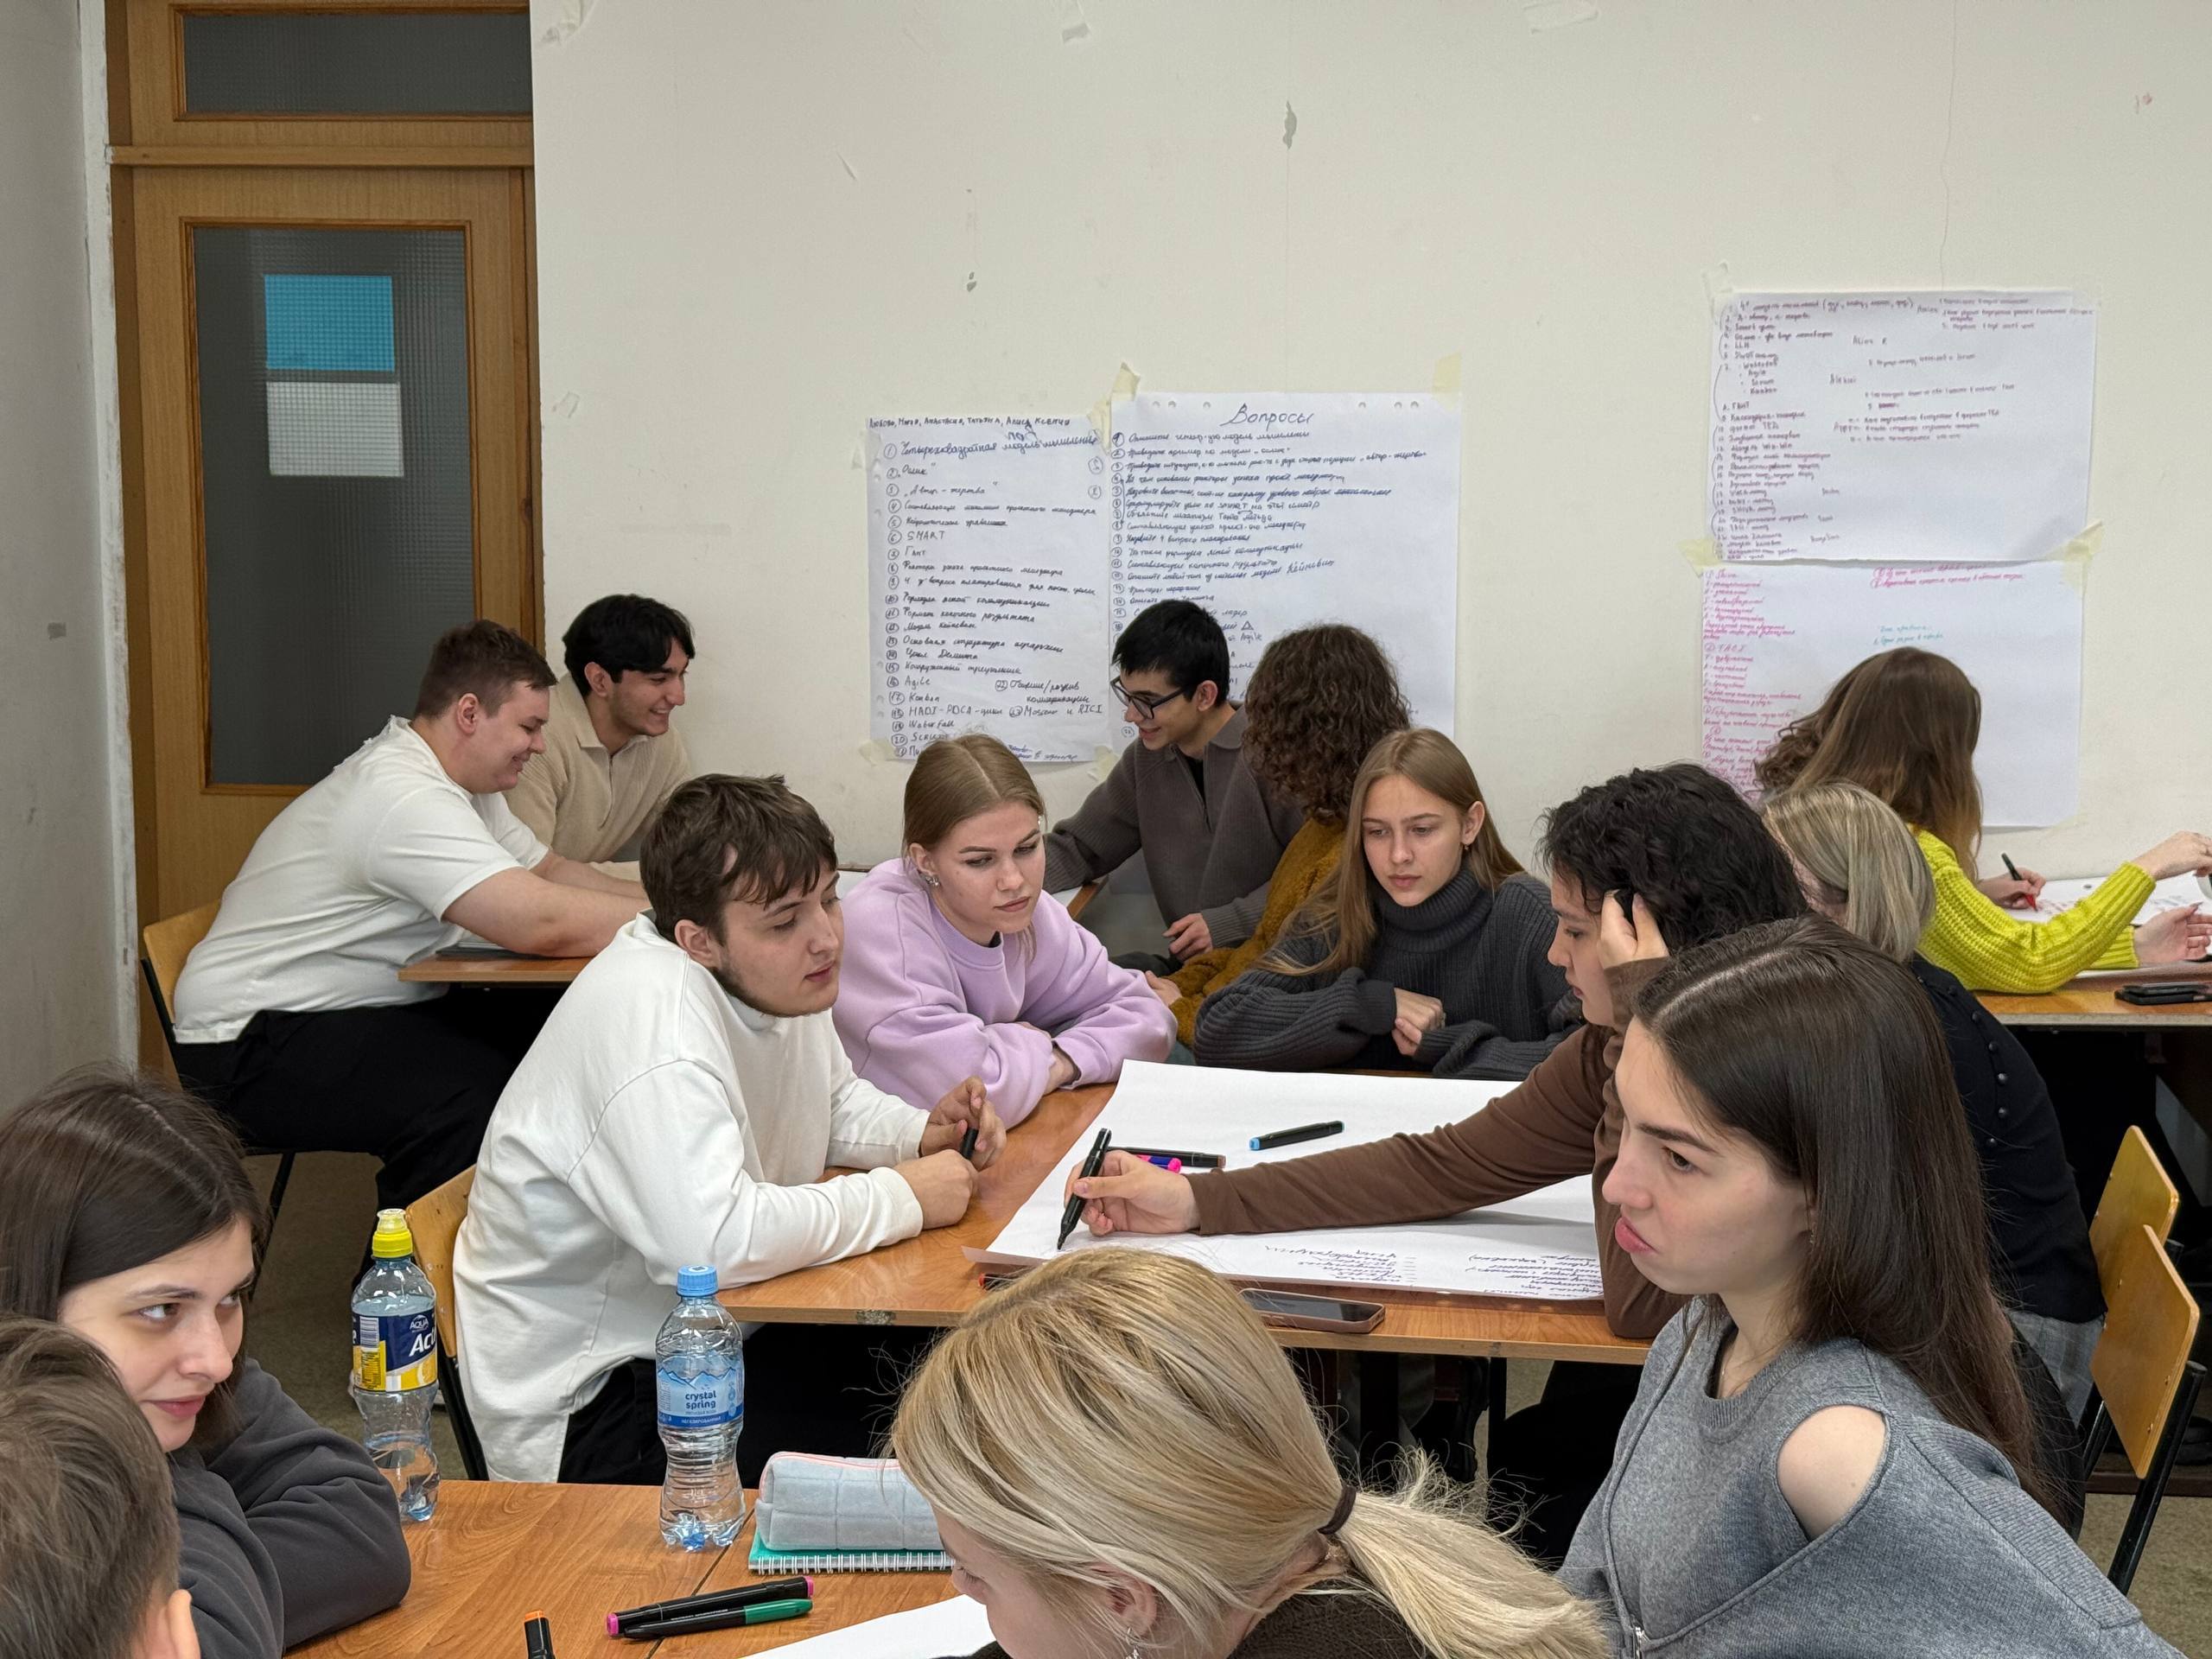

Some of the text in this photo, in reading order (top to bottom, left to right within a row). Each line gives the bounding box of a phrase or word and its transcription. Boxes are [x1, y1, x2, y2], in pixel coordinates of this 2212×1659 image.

[1219, 403, 1314, 431] Вопросы
[410, 1319, 429, 1330] AQUA
[685, 1390, 716, 1402] crystal
[686, 1400, 716, 1410] spring
